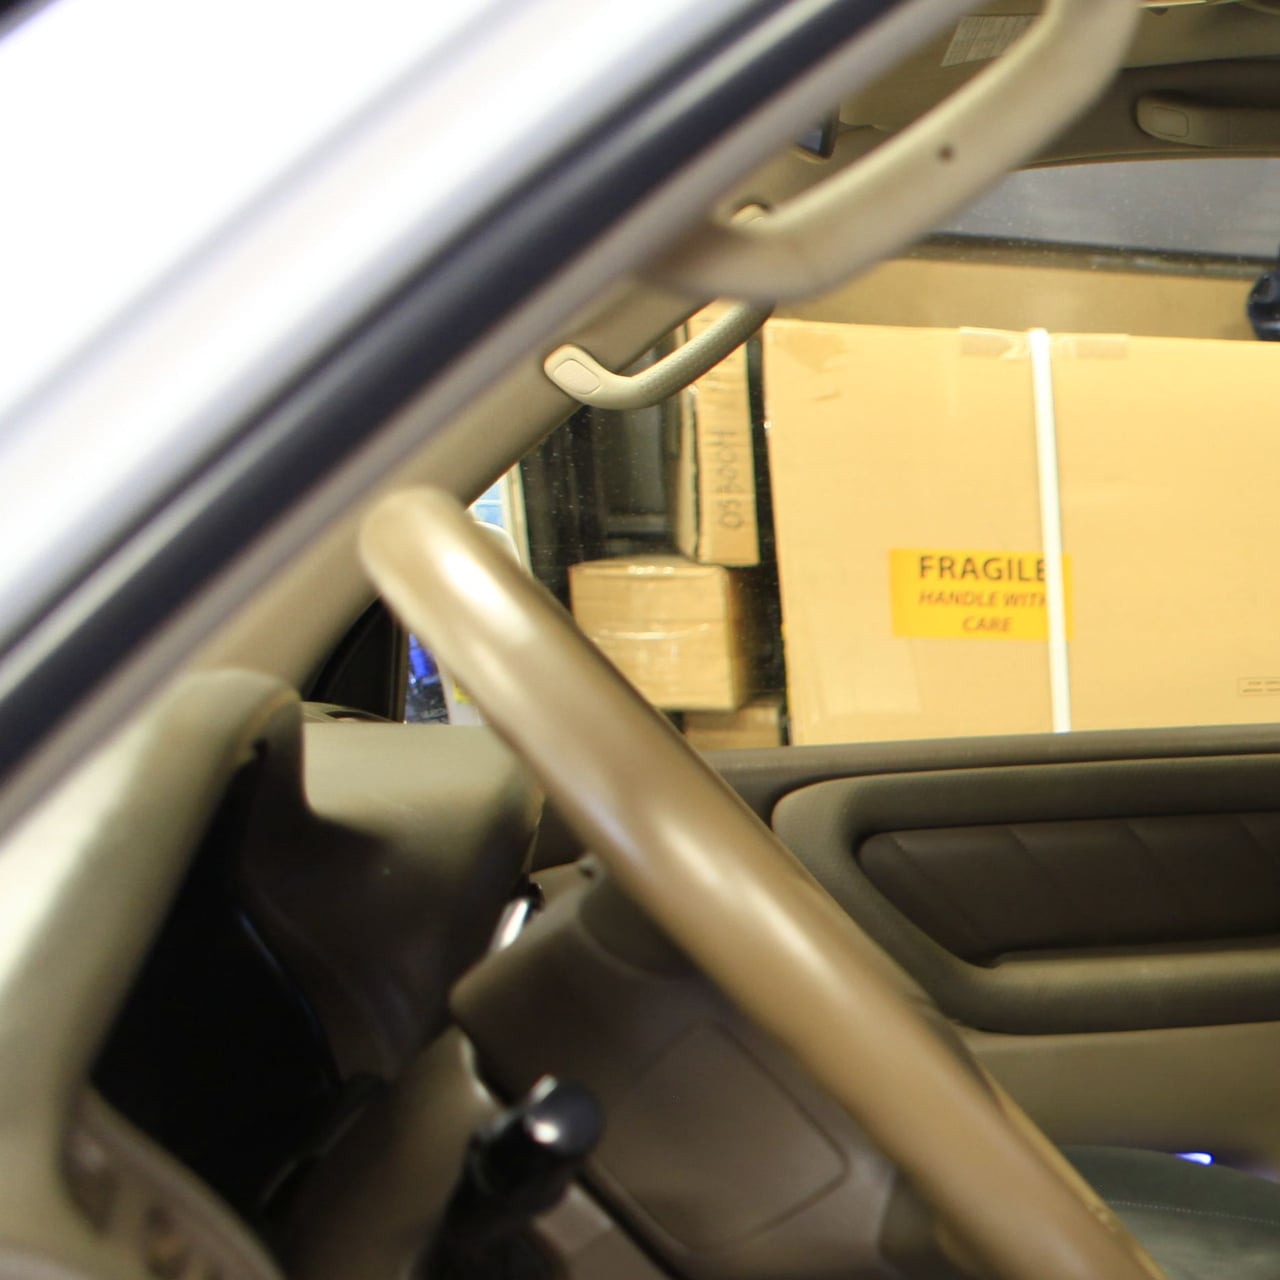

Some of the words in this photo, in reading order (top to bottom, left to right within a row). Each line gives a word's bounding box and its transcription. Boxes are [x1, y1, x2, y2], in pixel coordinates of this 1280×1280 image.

[919, 555, 1046, 582] FRAGILE
[919, 590, 997, 606] HANDLE
[962, 616, 1013, 632] CARE
